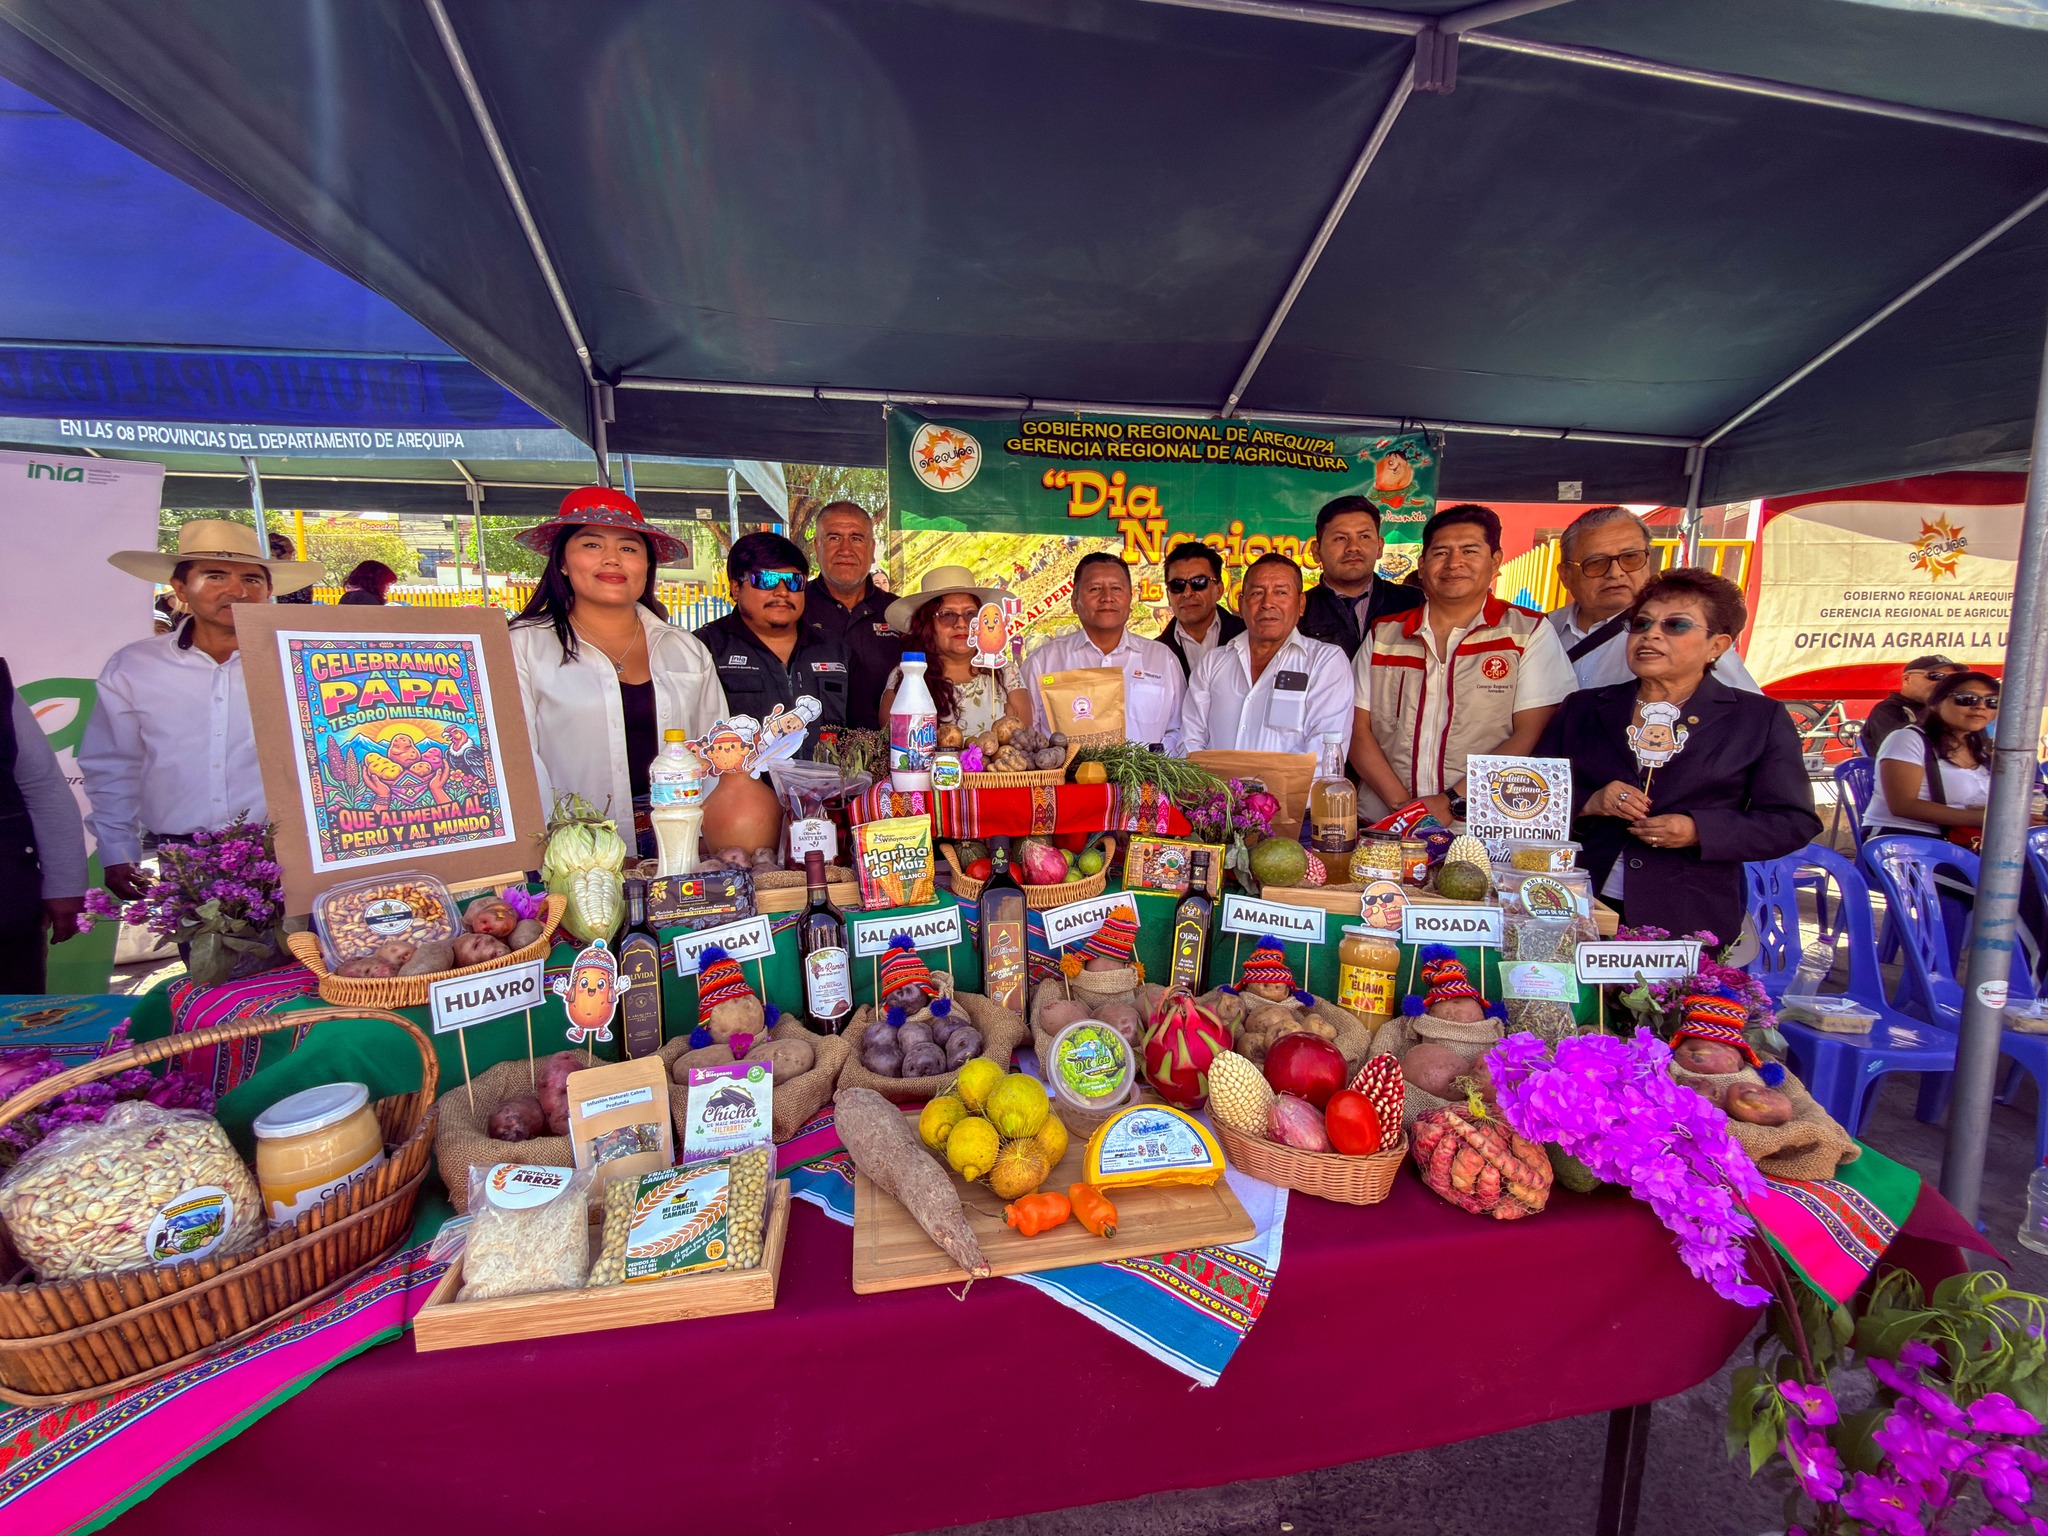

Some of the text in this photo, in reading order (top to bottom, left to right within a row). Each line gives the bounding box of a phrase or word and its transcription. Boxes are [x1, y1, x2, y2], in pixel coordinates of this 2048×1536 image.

[60, 420, 464, 450] EN LAS 08 PROVINCIAS DEL DEPARTAMENTO DE AREQUIPA
[1023, 421, 1335, 454] GOBIERNO REGIONAL DE AREQUIPA
[1007, 438, 1348, 471] GERENCIA REGIONAL DE AGRICULTURA
[27, 459, 84, 483] inia
[1140, 578, 1163, 600] la
[1843, 591, 2014, 602] GOBIERNO REGIONAL AREQUIP
[1026, 605, 1045, 622] AL
[1820, 608, 2013, 618] GERENCIA REGIONAL DE AGRICUL
[1794, 632, 1876, 649] OFICINA
[1882, 632, 1965, 648] AGRARIA
[1971, 632, 1992, 647] LA
[310, 652, 463, 681] CELEBRAMOS
[371, 671, 410, 679] A LA
[318, 678, 469, 716] PAPA
[329, 706, 467, 732] TESORO MILENARIO
[339, 797, 485, 832] QUE ALIMENTA AL
[341, 816, 491, 850] PERÚ Y AL MUNDO
[1474, 825, 1561, 840] CAPPUCCINO
[863, 844, 928, 868] Harina
[872, 864, 889, 878] de
[899, 872, 927, 880] BLANCO
[1541, 878, 1564, 891] CHIPS
[1055, 904, 1125, 932] CANCHA
[1232, 907, 1314, 931] AMARILLA
[1415, 917, 1491, 933] ROSADA
[861, 919, 956, 943] SALAMANCA
[1586, 953, 1687, 968] PERUANITA
[445, 977, 535, 1013] HUAYRO
[1352, 981, 1384, 995] ELIANA
[606, 1099, 629, 1108] Profunda
[702, 1103, 757, 1123] Chicha
[512, 1174, 563, 1186] ARROZ
[517, 1170, 554, 1178] PROYECTO
[642, 1172, 678, 1184] CANARIO
[648, 1169, 675, 1178] FRIJOL
[662, 1208, 696, 1219] CAMANEJA
[672, 1201, 698, 1211] CHACRA
[628, 1260, 648, 1268] PEDIDOS
